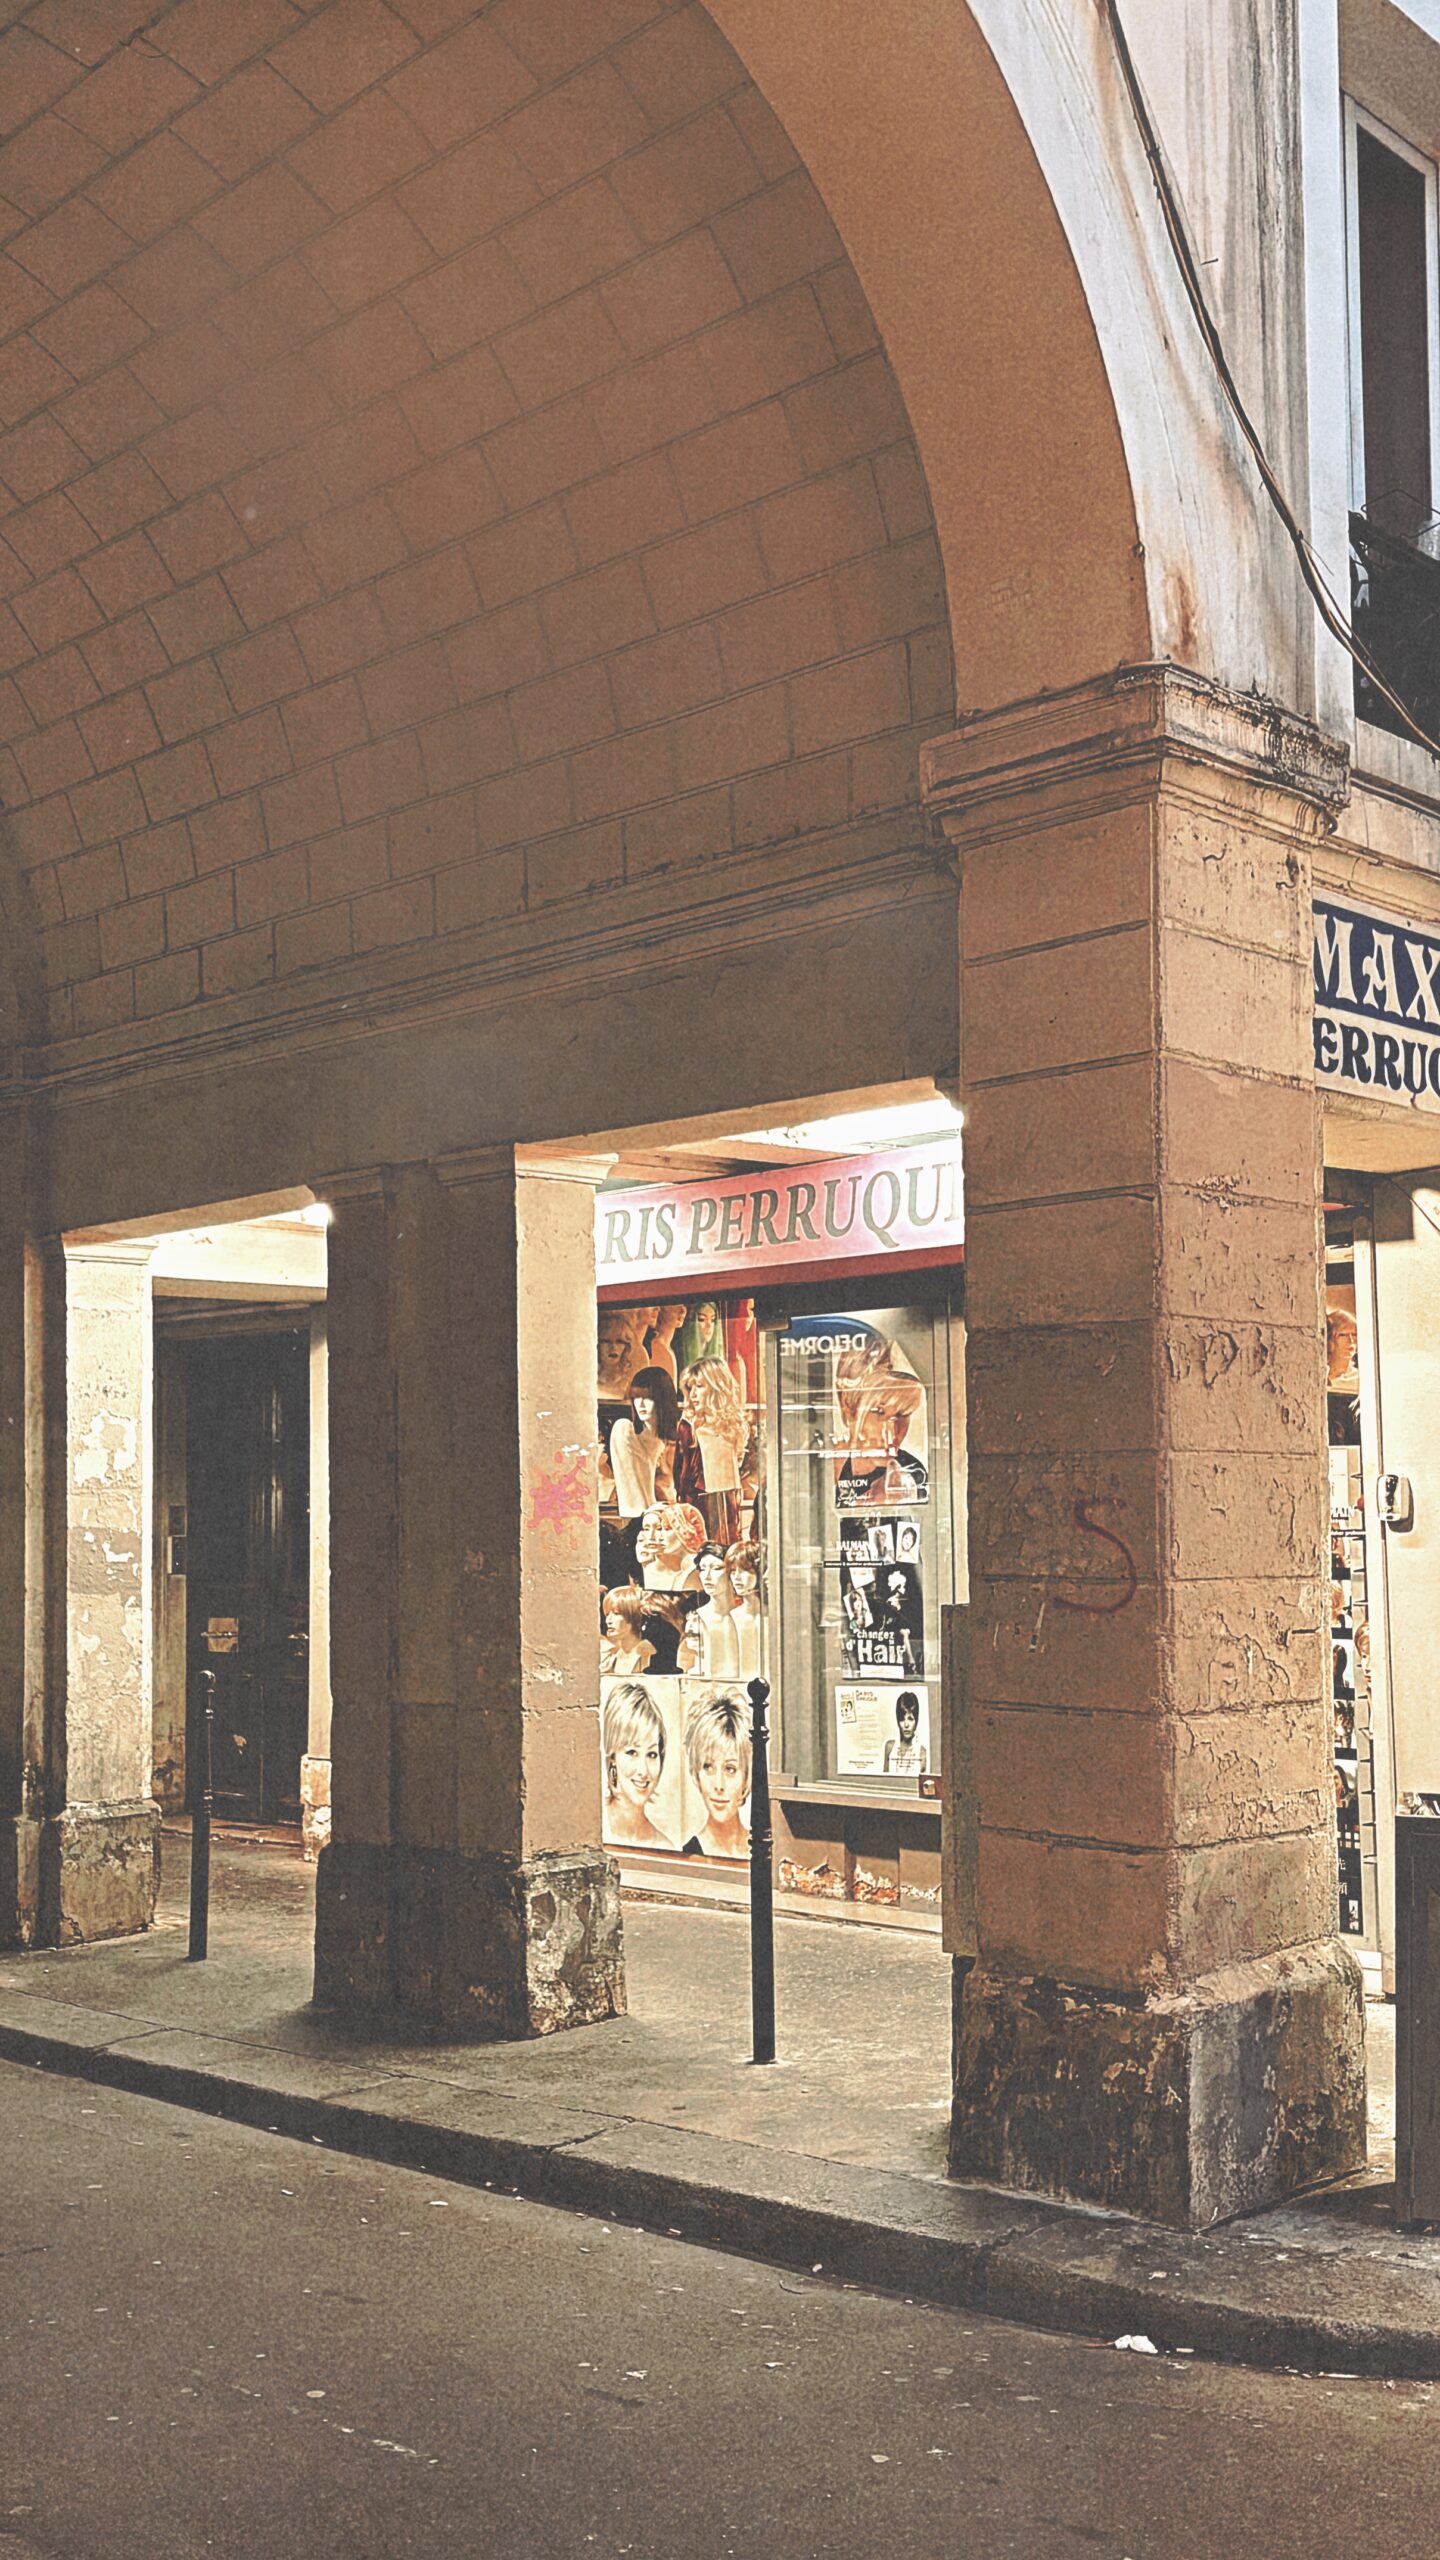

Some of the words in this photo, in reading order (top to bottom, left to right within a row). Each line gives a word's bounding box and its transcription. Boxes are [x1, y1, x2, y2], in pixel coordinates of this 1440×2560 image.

[1313, 912, 1440, 1024] MAX
[600, 1203, 676, 1264] RIS
[838, 1478, 869, 1488] REVLON
[856, 1629, 895, 1641] changez
